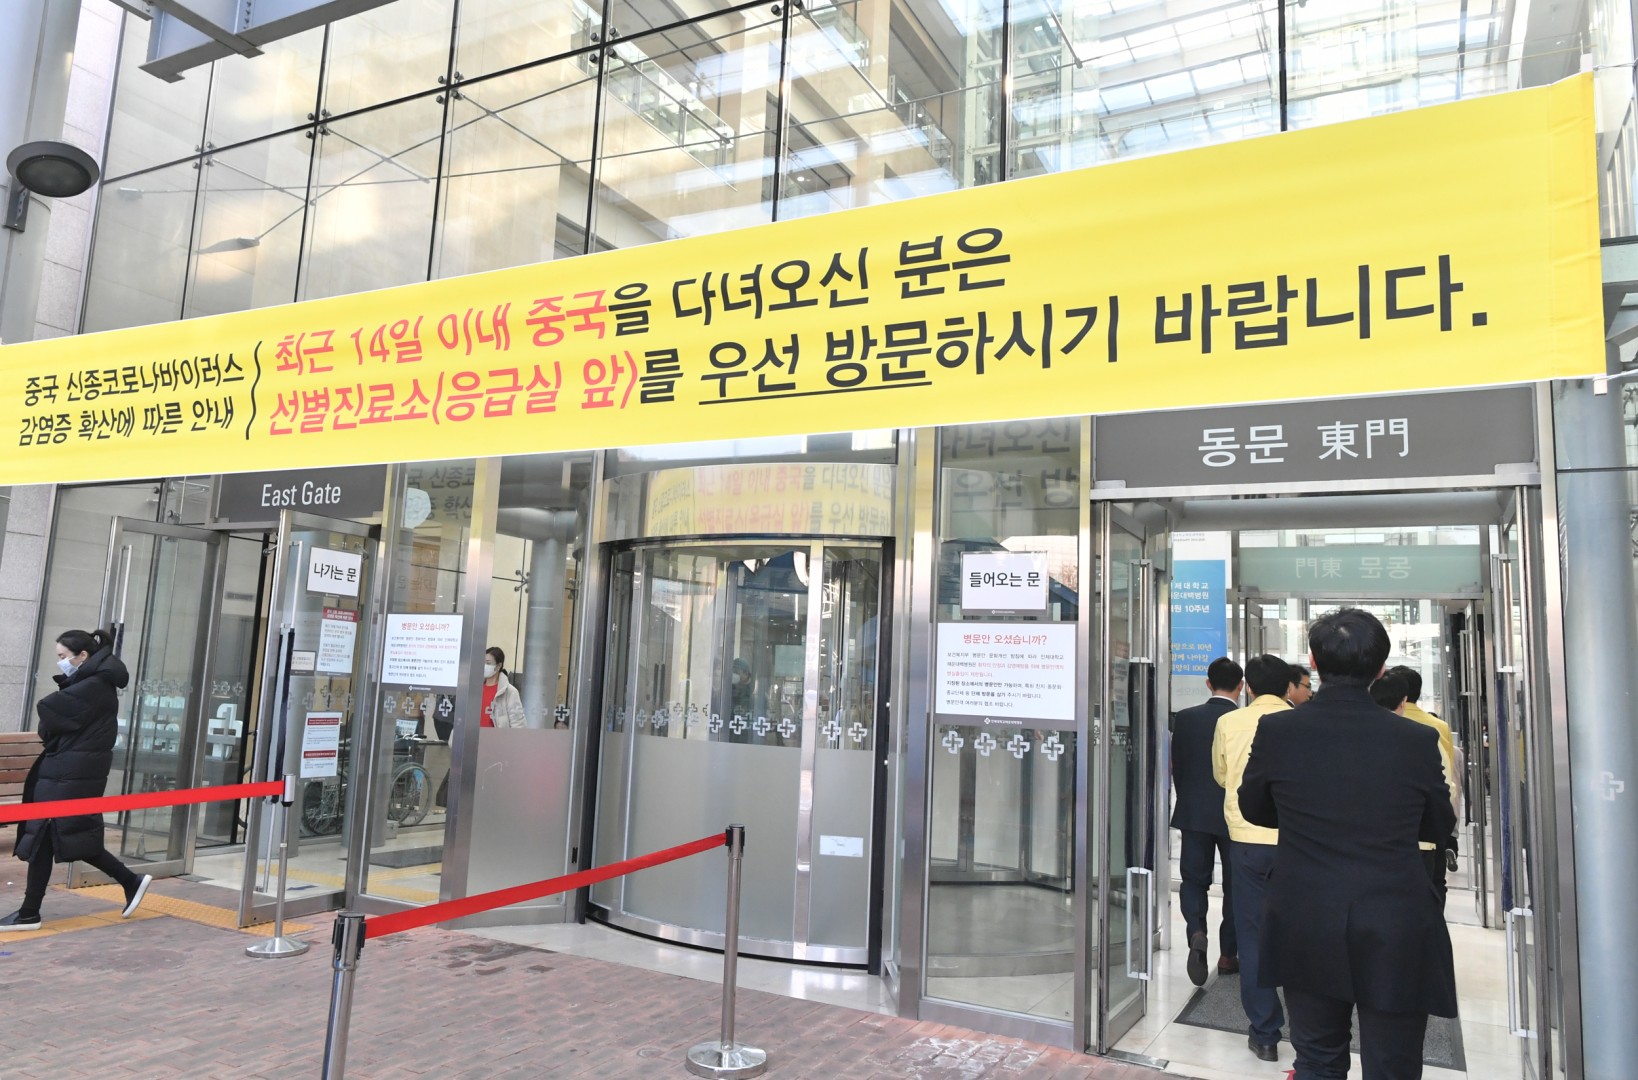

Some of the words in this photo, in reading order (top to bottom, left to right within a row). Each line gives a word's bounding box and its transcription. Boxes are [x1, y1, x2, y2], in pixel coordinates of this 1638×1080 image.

[276, 331, 334, 375] 최근
[351, 316, 423, 366] 14일
[437, 304, 511, 356] 이내
[526, 283, 651, 346] 중국을
[673, 248, 868, 326] 다녀오신
[895, 228, 1010, 298] 분은
[270, 360, 561, 437] 선별진료소(응급실
[582, 349, 683, 410] 앞)를
[701, 334, 800, 398] 우선
[826, 295, 1118, 387] 방문하시기
[1155, 255, 1488, 354] 바랍니다.
[25, 374, 58, 406] 중국
[66, 354, 245, 402] 신종코로나바이러스
[19, 414, 72, 446] 감염증
[78, 406, 135, 440] 확산에
[143, 402, 183, 435] 따른
[191, 395, 234, 431] 안내
[1198, 424, 1289, 468] 동문
[1317, 418, 1409, 460] 東門
[261, 484, 297, 507] East
[301, 481, 342, 506] Gate
[314, 562, 344, 582] 나가는
[346, 567, 357, 583] 문
[969, 571, 1023, 588] 들어오는
[1026, 571, 1041, 588] 문
[1185, 604, 1210, 613] 10주년
[401, 622, 418, 631] 병문안
[419, 623, 450, 631] 오셨습니까?
[963, 634, 990, 645] 병문안
[994, 634, 1047, 646] 오셨습니까?
